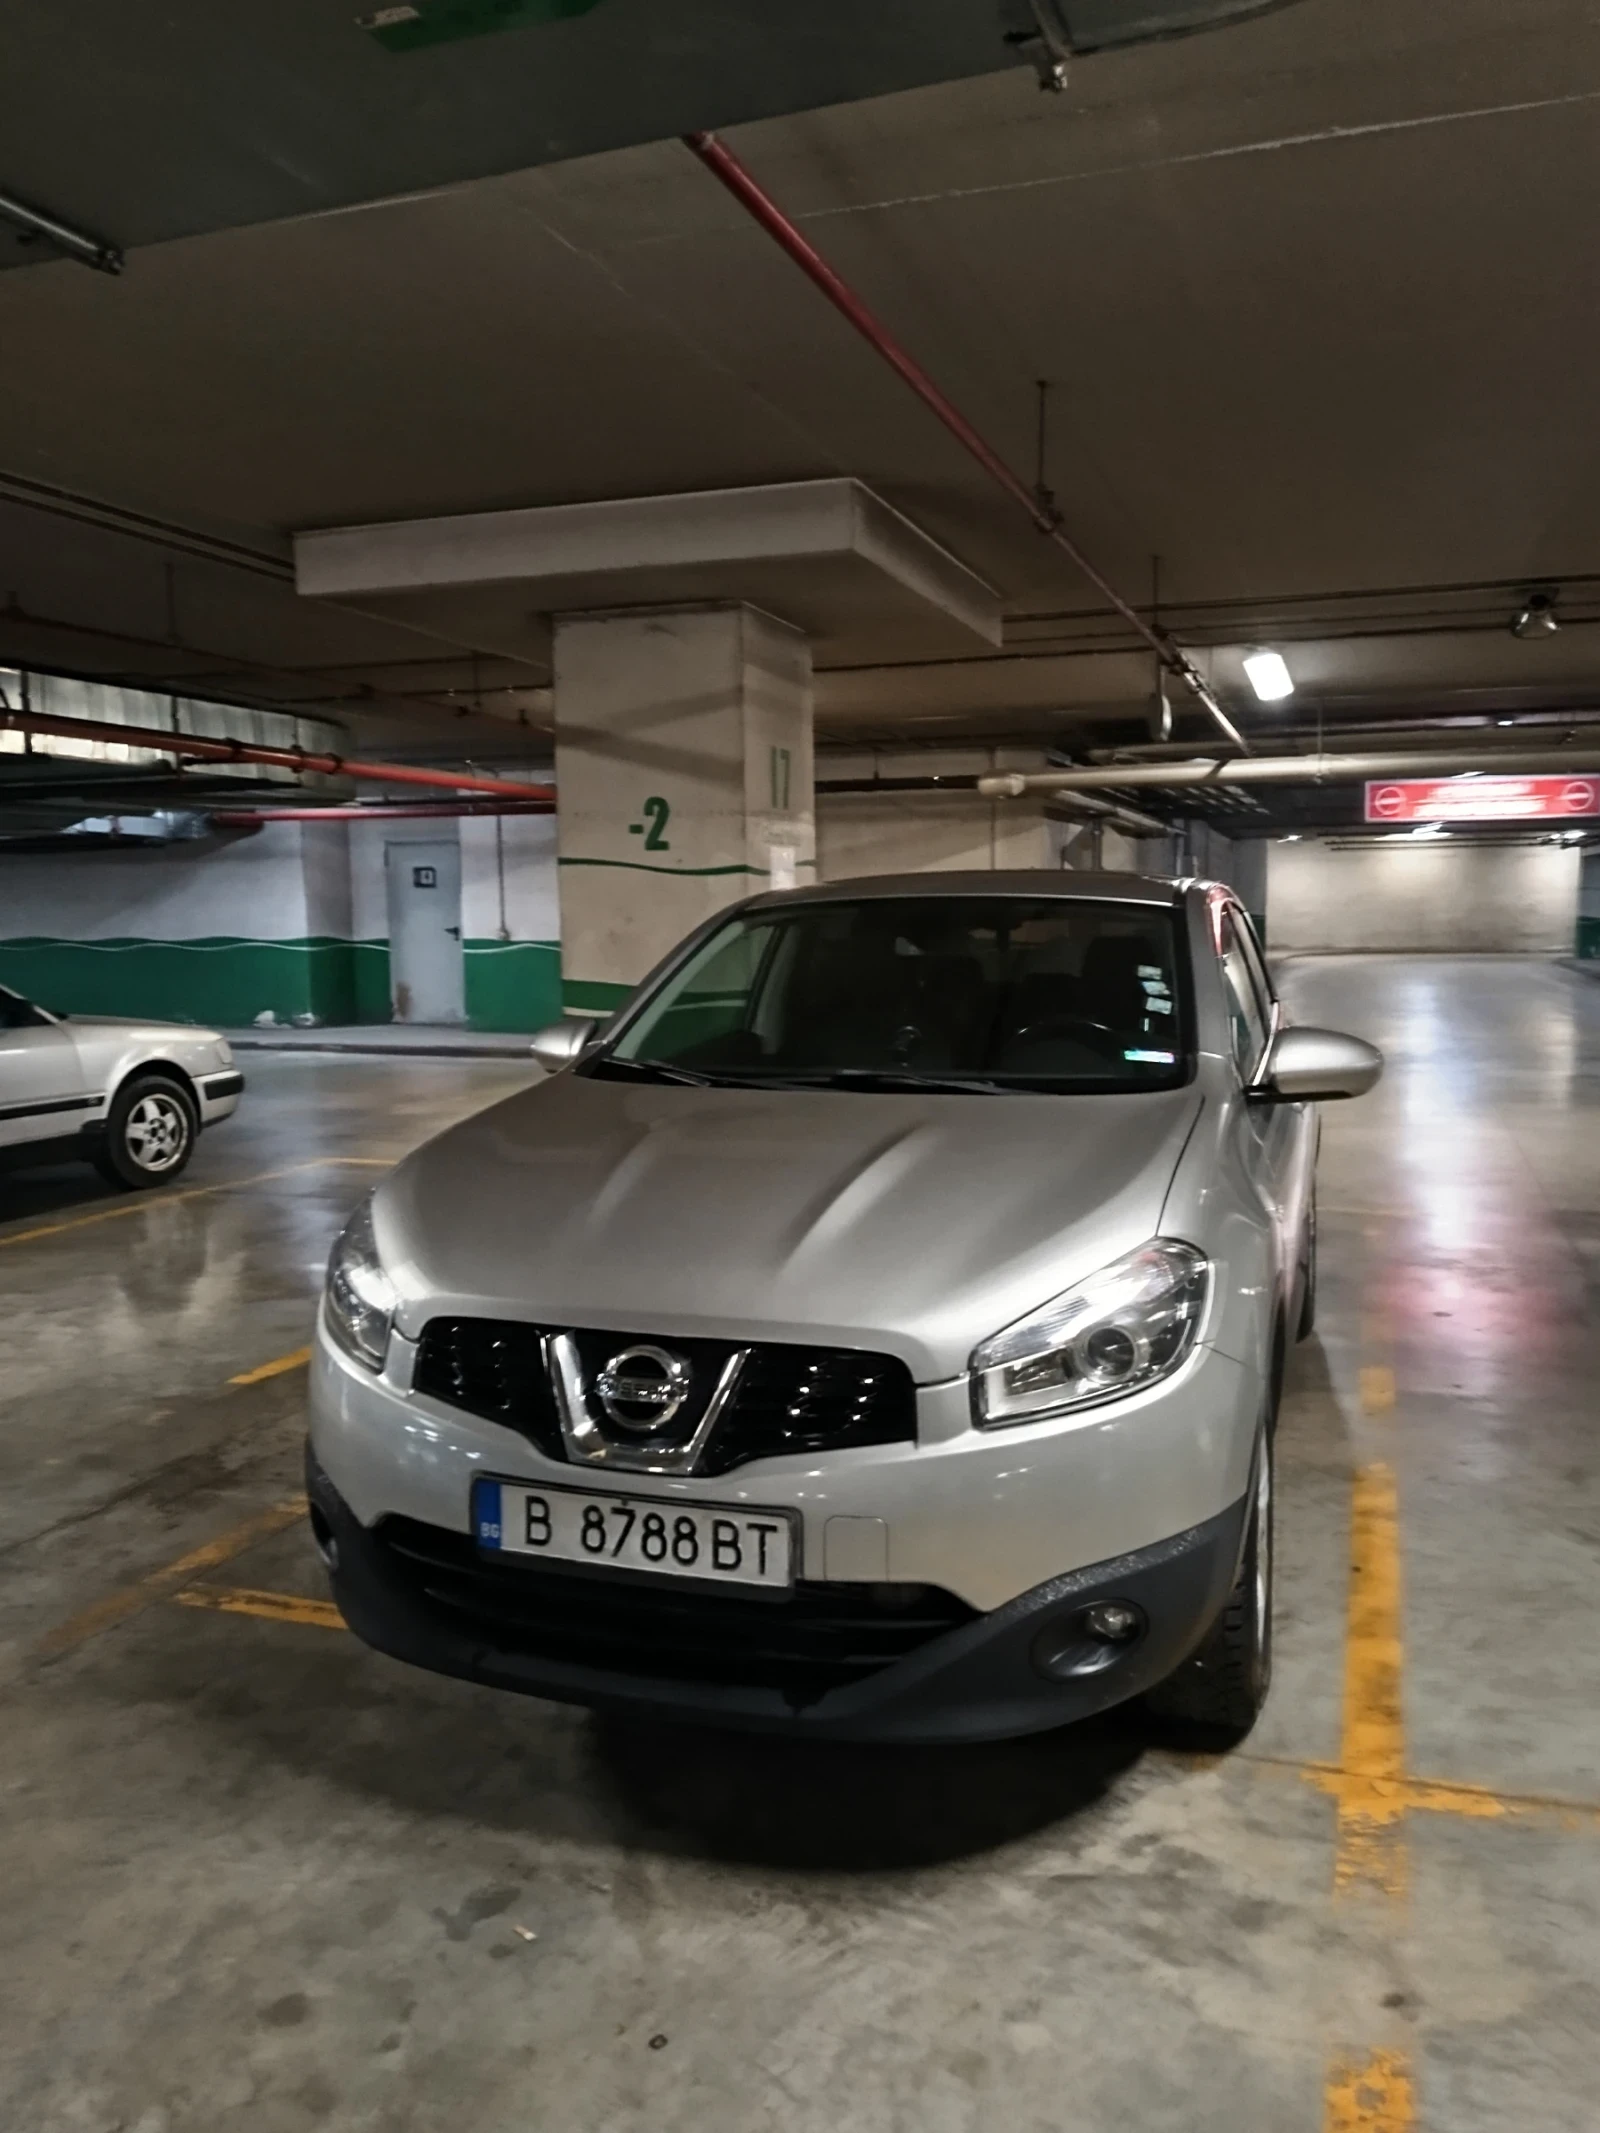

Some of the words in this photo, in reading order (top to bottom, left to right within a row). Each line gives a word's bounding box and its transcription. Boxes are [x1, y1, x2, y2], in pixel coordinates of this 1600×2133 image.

[628, 796, 670, 851] -2
[481, 1521, 500, 1538] BG
[525, 1495, 552, 1547] B
[580, 1504, 699, 1567] 8788
[712, 1519, 778, 1575] BT
